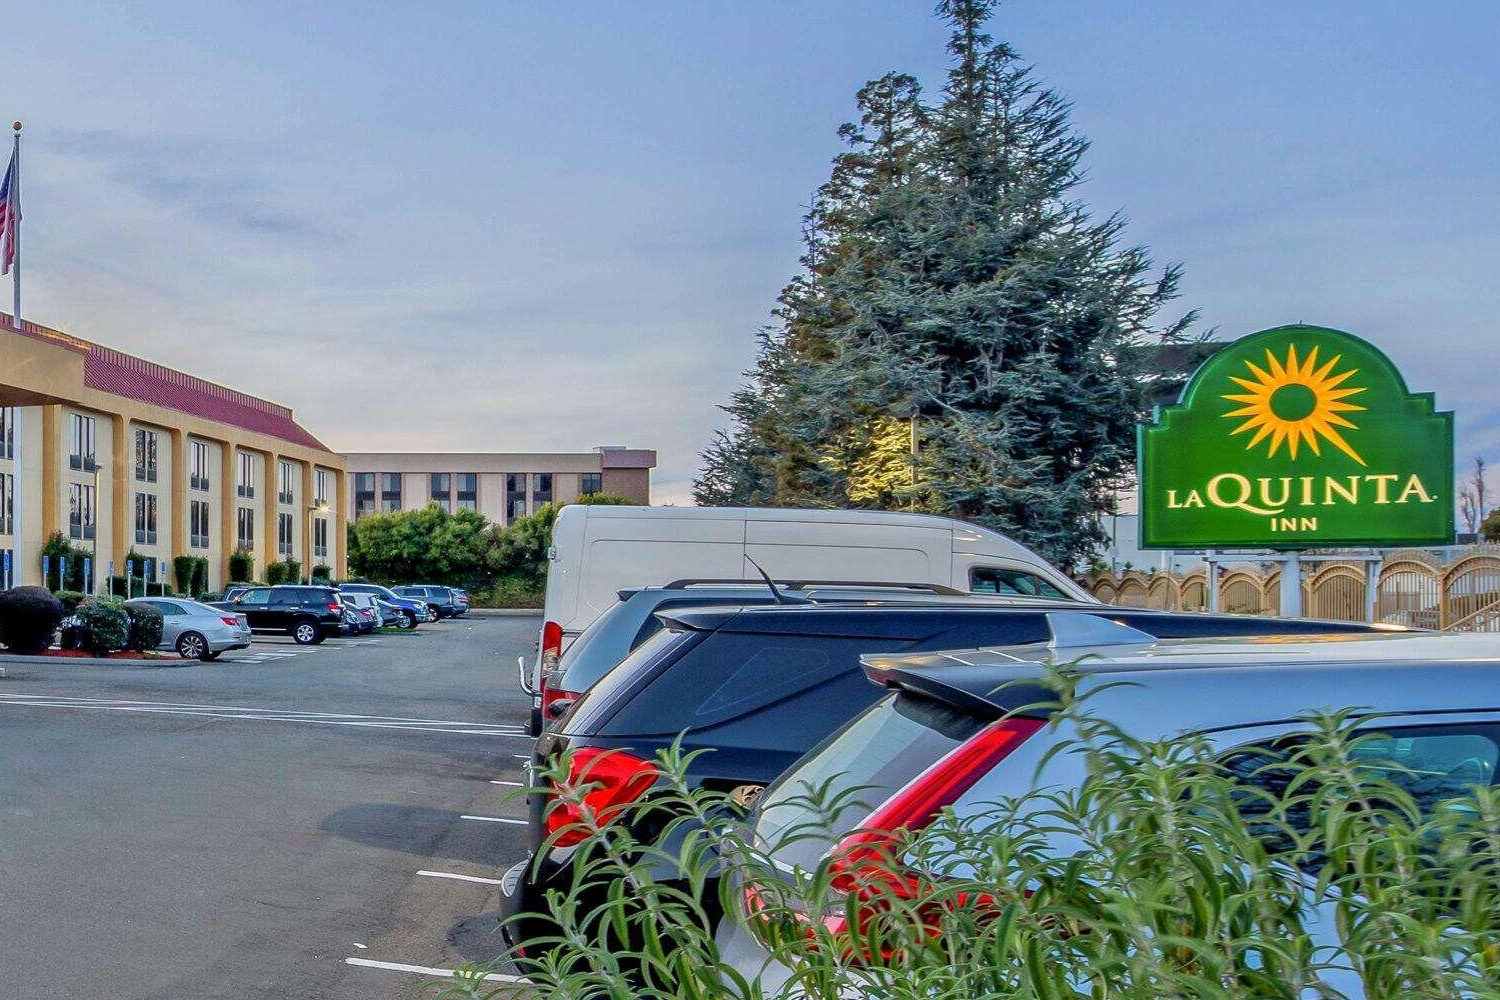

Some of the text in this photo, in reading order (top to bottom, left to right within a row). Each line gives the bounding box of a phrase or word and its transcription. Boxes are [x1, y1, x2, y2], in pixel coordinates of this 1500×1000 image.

[1167, 473, 1434, 515] LA QUINTA
[1270, 517, 1318, 532] INN
